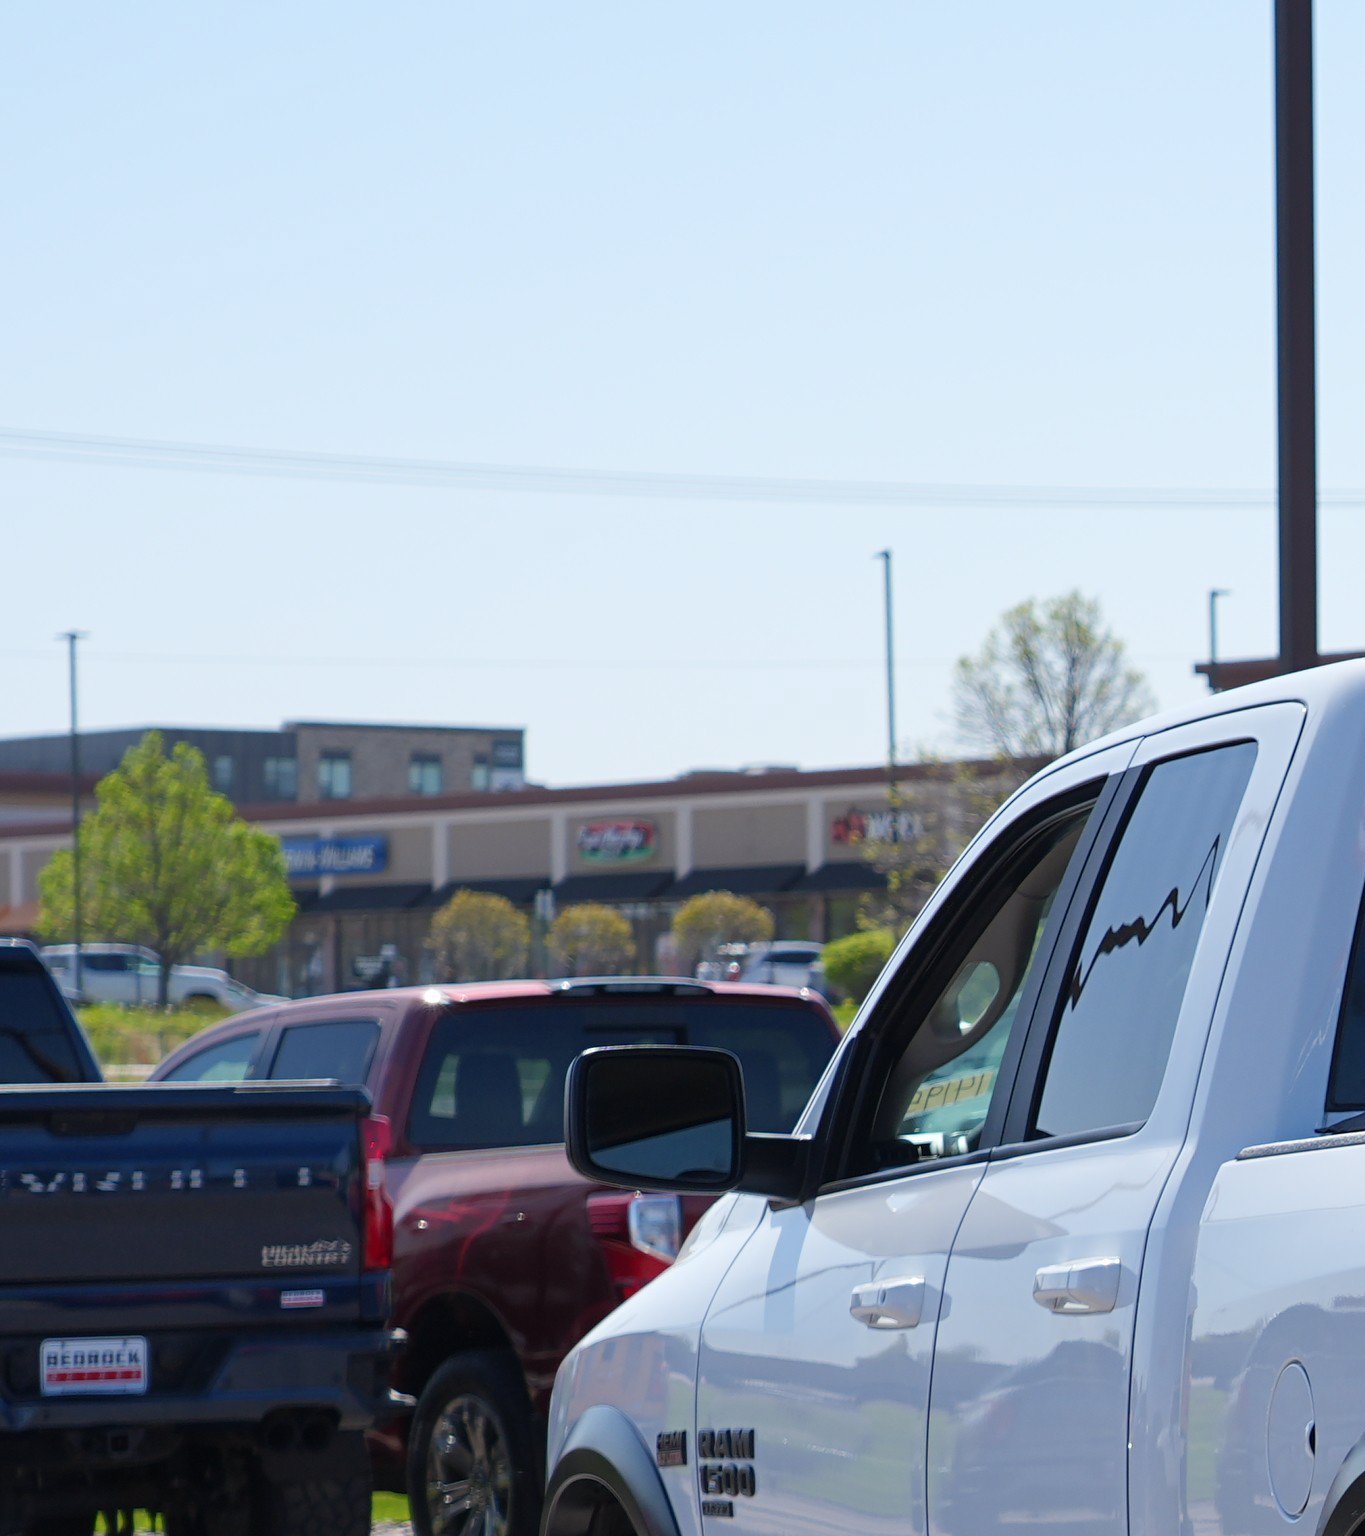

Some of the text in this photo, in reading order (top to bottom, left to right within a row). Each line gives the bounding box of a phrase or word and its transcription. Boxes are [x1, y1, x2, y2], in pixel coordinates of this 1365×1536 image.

[46, 1348, 141, 1366] BEDROCK
[698, 1427, 755, 1459] RAM
[700, 1463, 756, 1497] 1500
